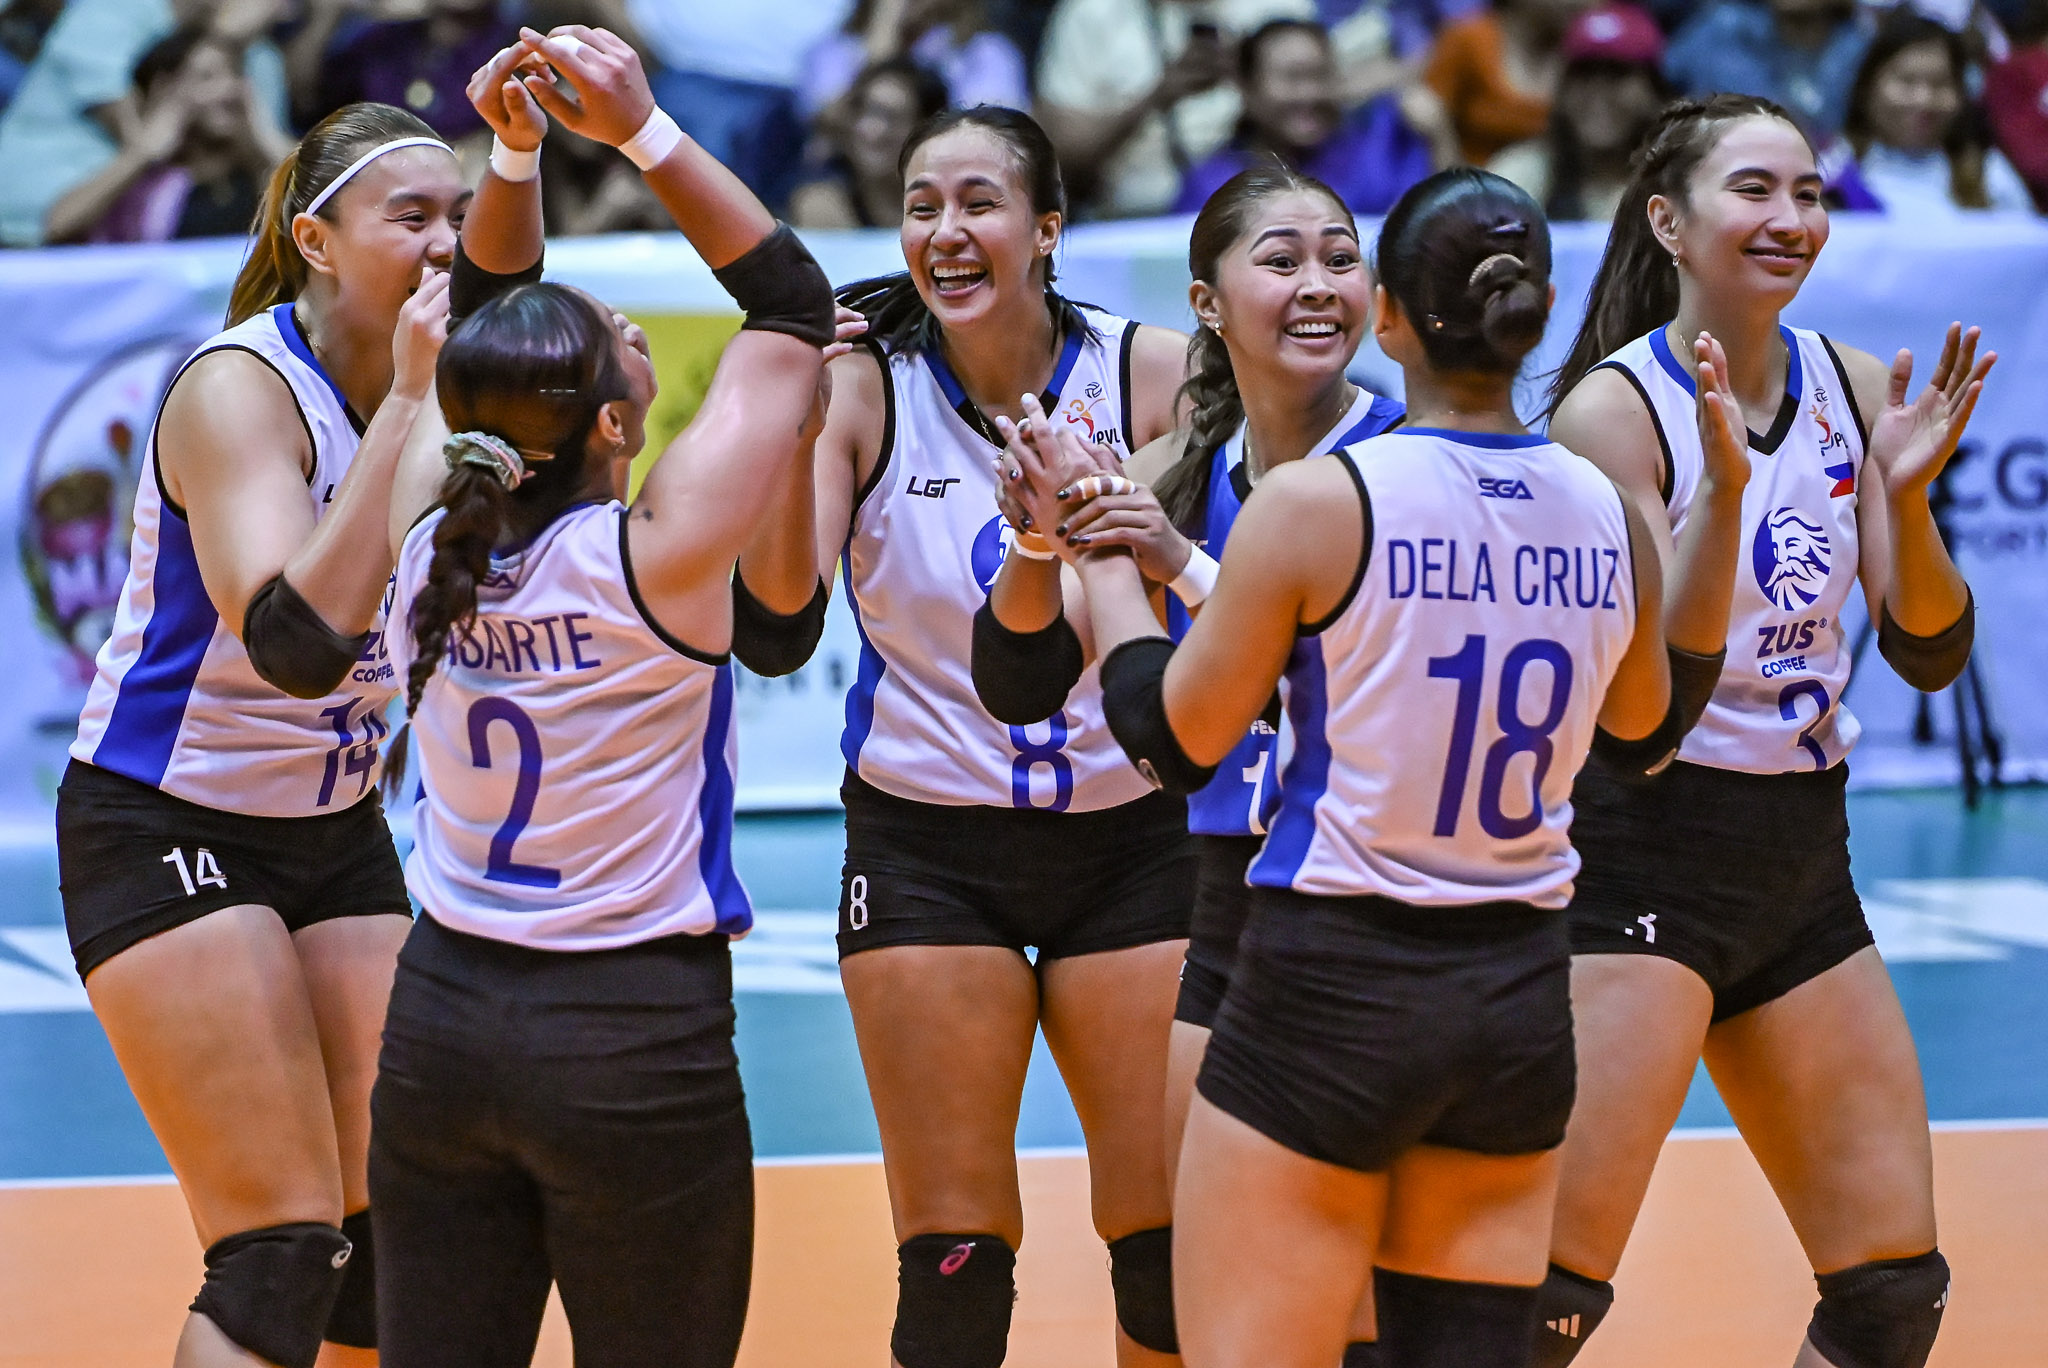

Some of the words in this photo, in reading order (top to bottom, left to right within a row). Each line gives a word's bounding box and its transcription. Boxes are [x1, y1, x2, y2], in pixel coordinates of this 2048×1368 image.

[1096, 427, 1121, 445] PVL
[1478, 477, 1535, 500] SGA
[1387, 538, 1497, 603] DELA
[1514, 544, 1619, 610] CRUZ
[1761, 654, 1807, 679] COFFEE
[316, 695, 386, 807] 14
[1008, 708, 1074, 813] 8
[1427, 634, 1574, 840] 18
[467, 696, 562, 889] 2
[162, 846, 228, 896] 14
[849, 874, 869, 931] 8
